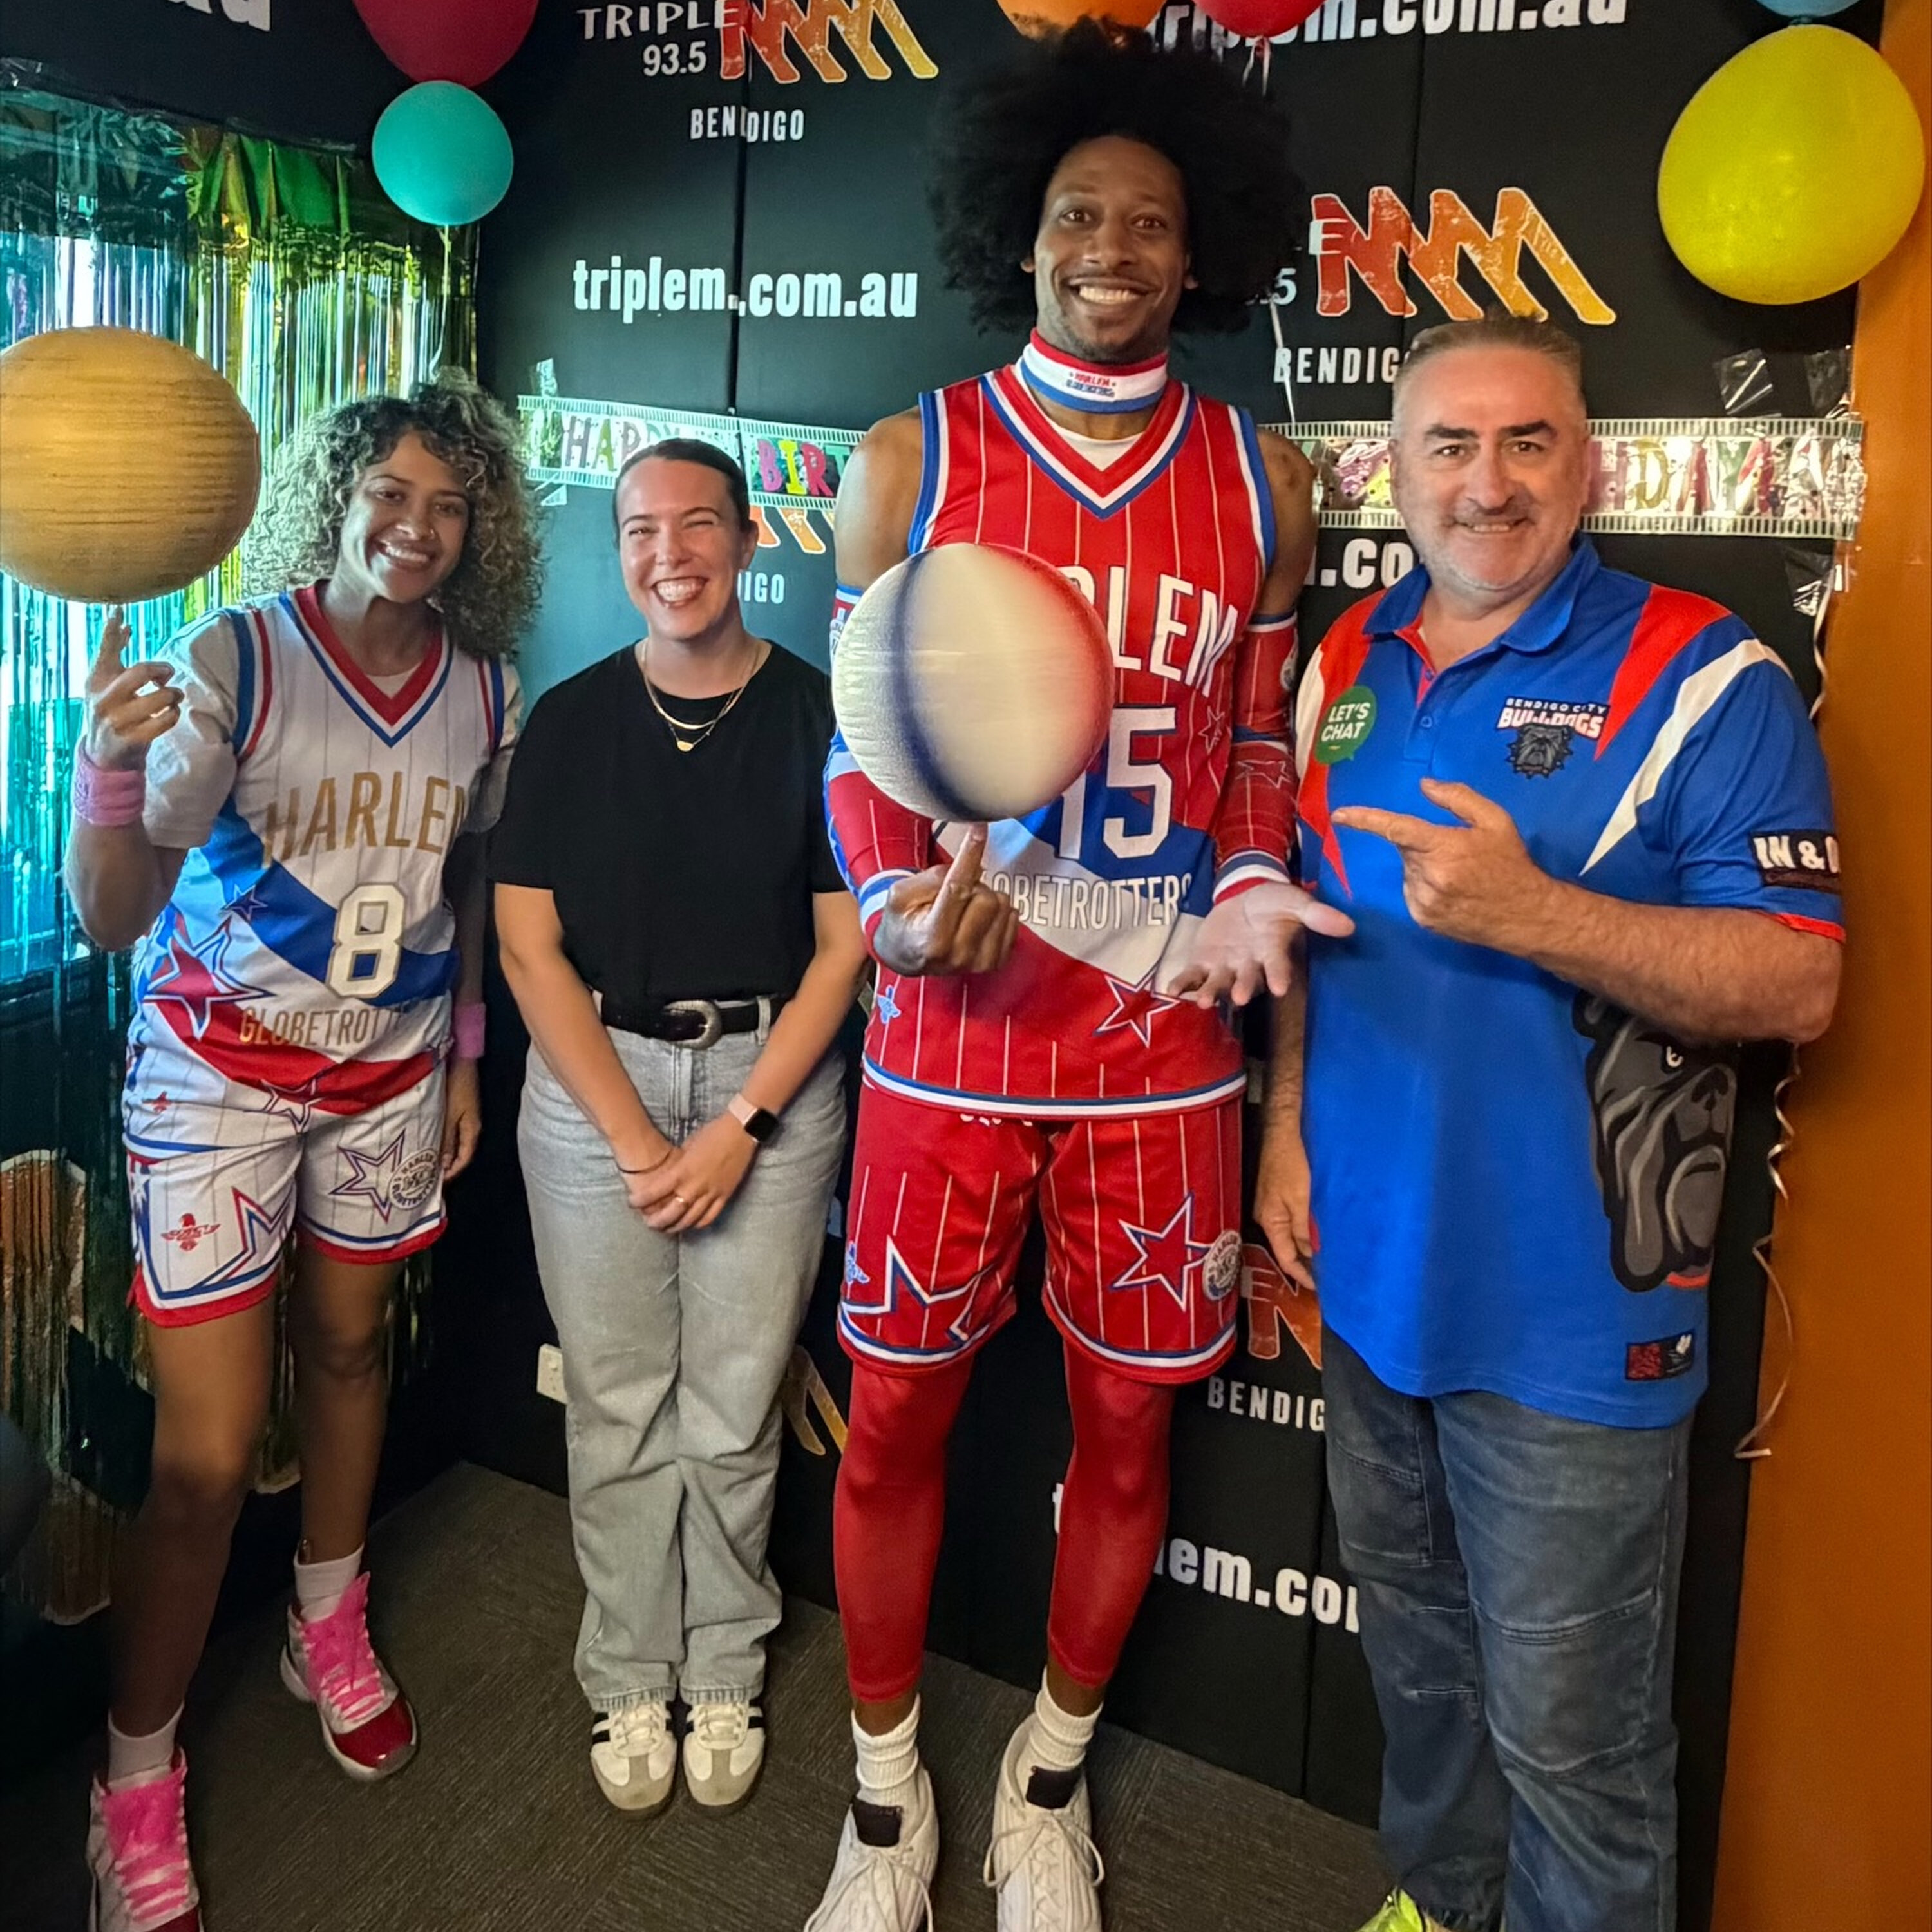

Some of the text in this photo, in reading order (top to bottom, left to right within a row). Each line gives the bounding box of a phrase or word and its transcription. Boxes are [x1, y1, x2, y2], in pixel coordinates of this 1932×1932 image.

[643, 40, 707, 77] 93.5
[573, 255, 918, 323] triplem.com.au
[1273, 346, 1411, 384] BENDIG
[737, 571, 785, 604] IGO
[1328, 701, 1371, 723] LET'S
[1497, 706, 1605, 739] BULLDOGS
[1505, 697, 1607, 714] BENDIGO CITY
[1321, 721, 1366, 742] CHAT
[1753, 835, 1797, 869] IN
[1797, 840, 1826, 870] &
[328, 882, 406, 998] 8
[1207, 1376, 1326, 1432] BENDIG
